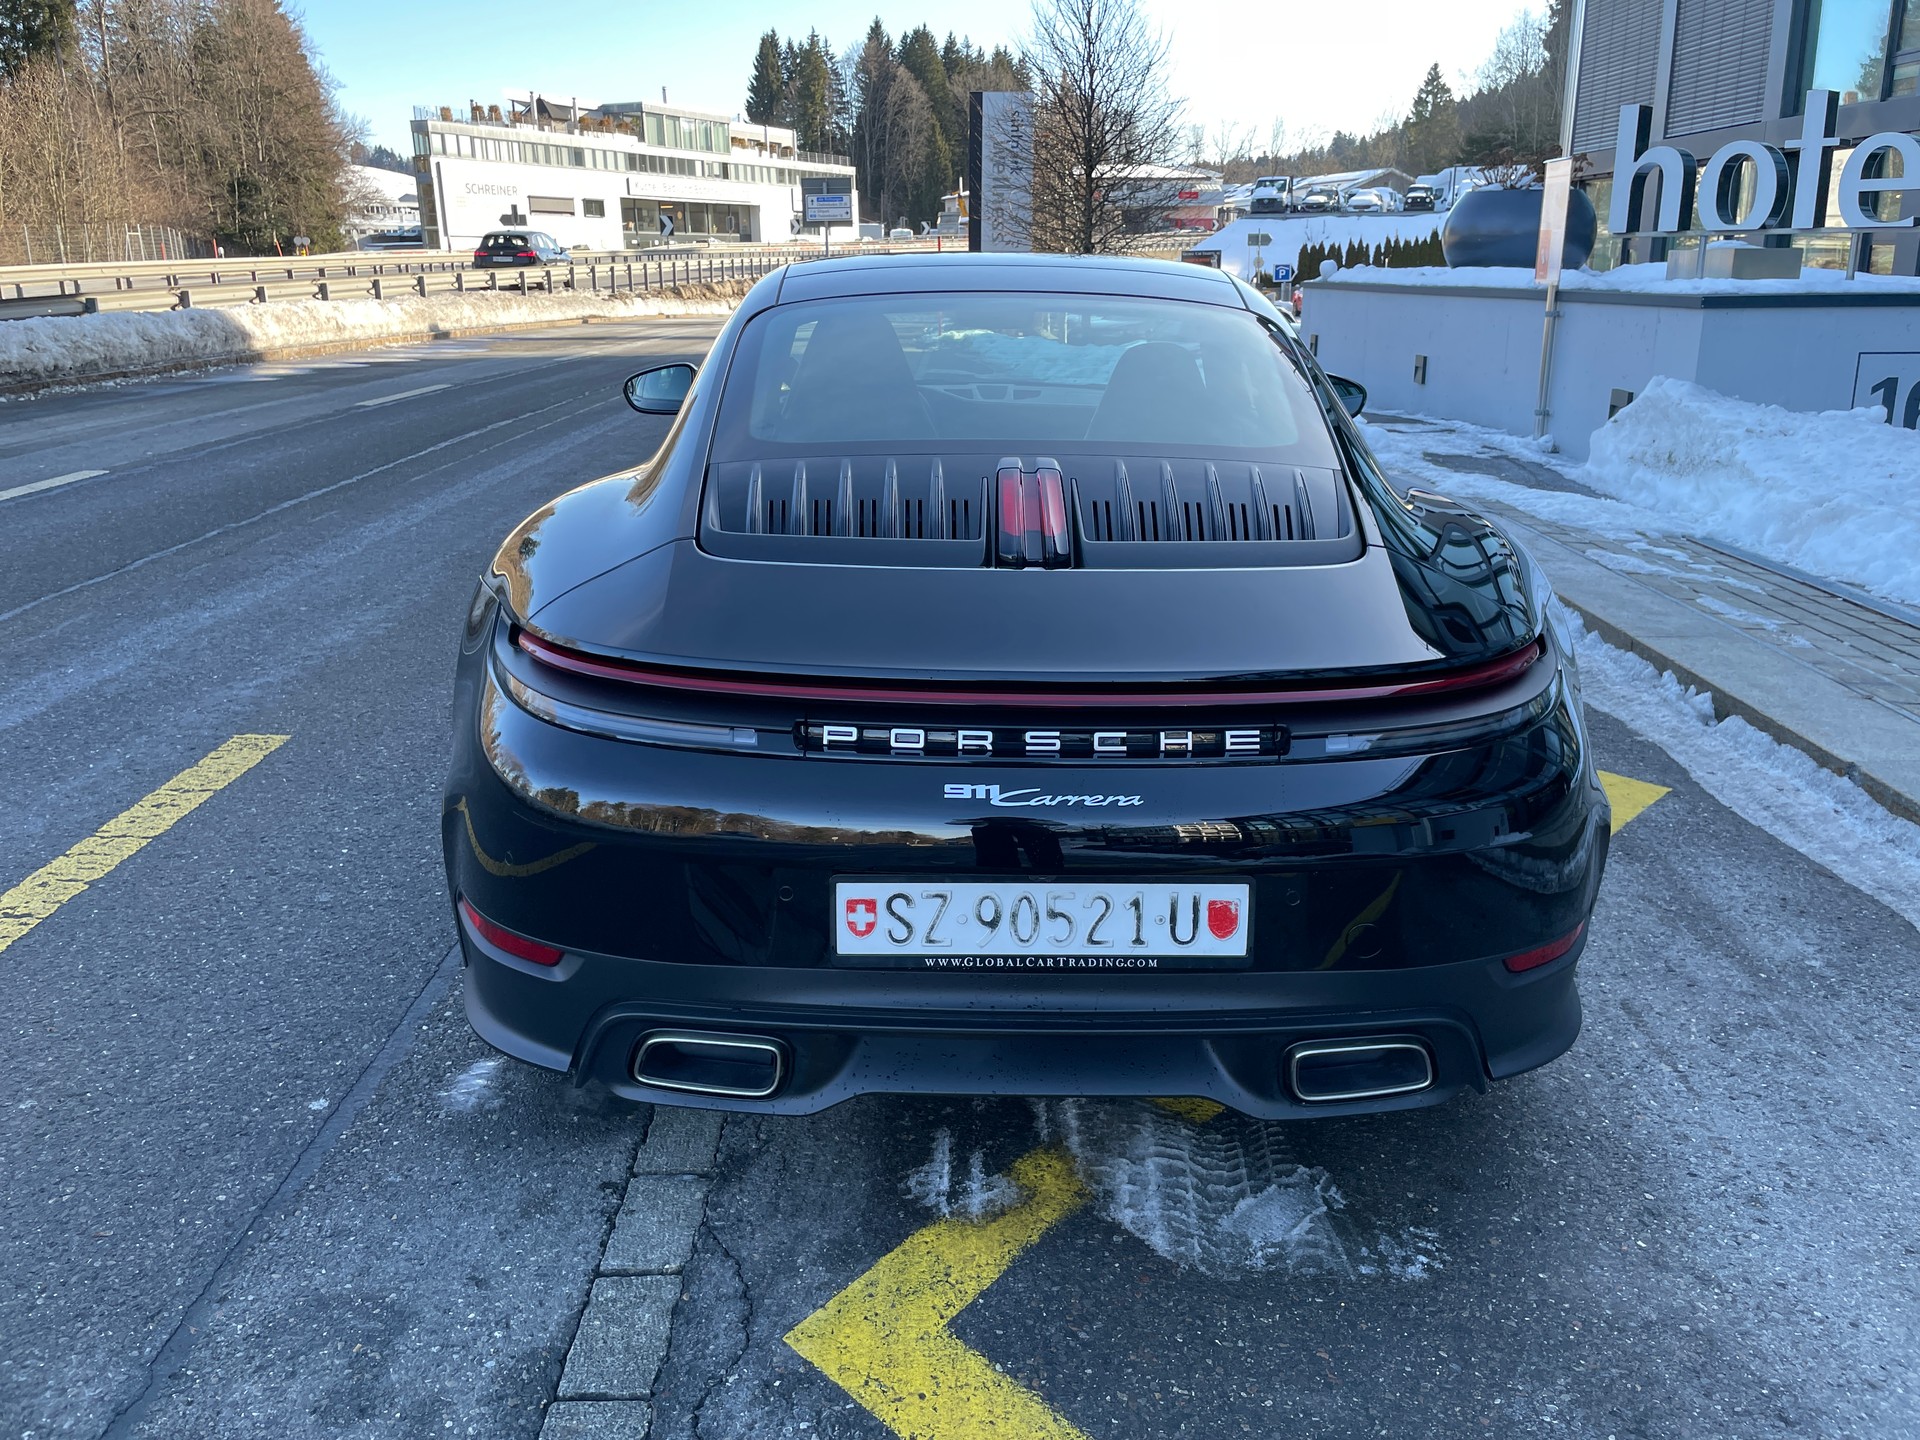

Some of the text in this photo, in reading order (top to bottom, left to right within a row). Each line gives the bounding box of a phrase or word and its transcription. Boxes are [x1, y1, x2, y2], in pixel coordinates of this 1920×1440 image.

[1010, 110, 1023, 175] sihlpk
[1608, 89, 1920, 233] hote
[465, 183, 518, 196] SCHREINER
[1279, 270, 1286, 279] P
[822, 725, 1261, 751] PORSCHE
[943, 783, 1144, 807] 911 Carrera
[884, 891, 1201, 948] SZ 90521 U
[924, 956, 1159, 969] WWW.GLOBALCARTRADING.COM
